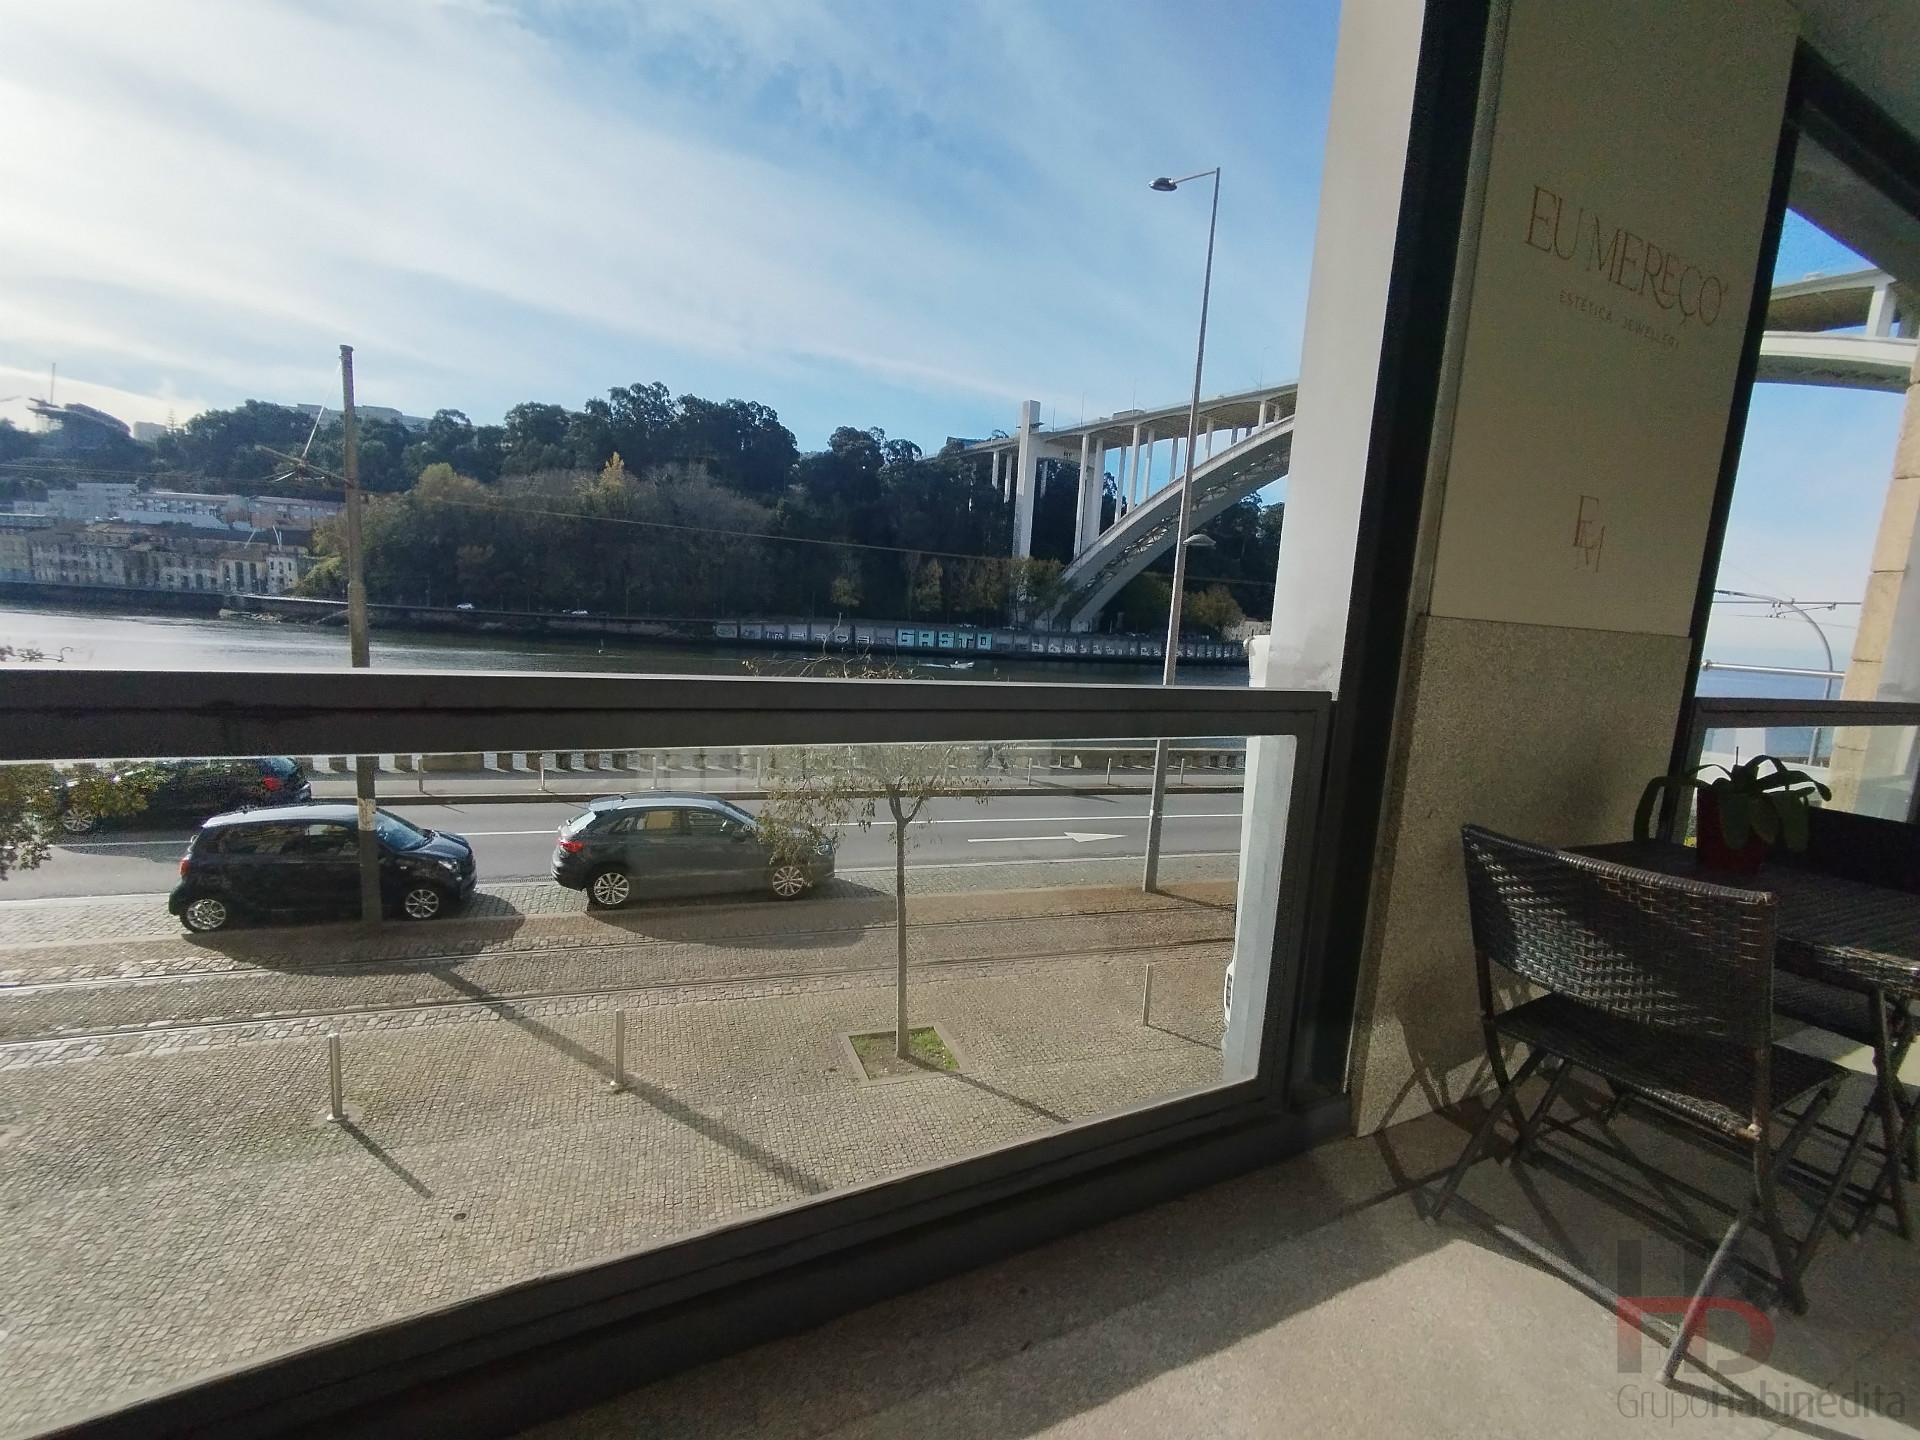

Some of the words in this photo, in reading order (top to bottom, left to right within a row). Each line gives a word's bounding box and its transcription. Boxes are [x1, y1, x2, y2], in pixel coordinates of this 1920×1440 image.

[1525, 185, 1583, 260] EU
[1585, 213, 1729, 327] MEREÇO
[897, 629, 993, 650] GASTO
